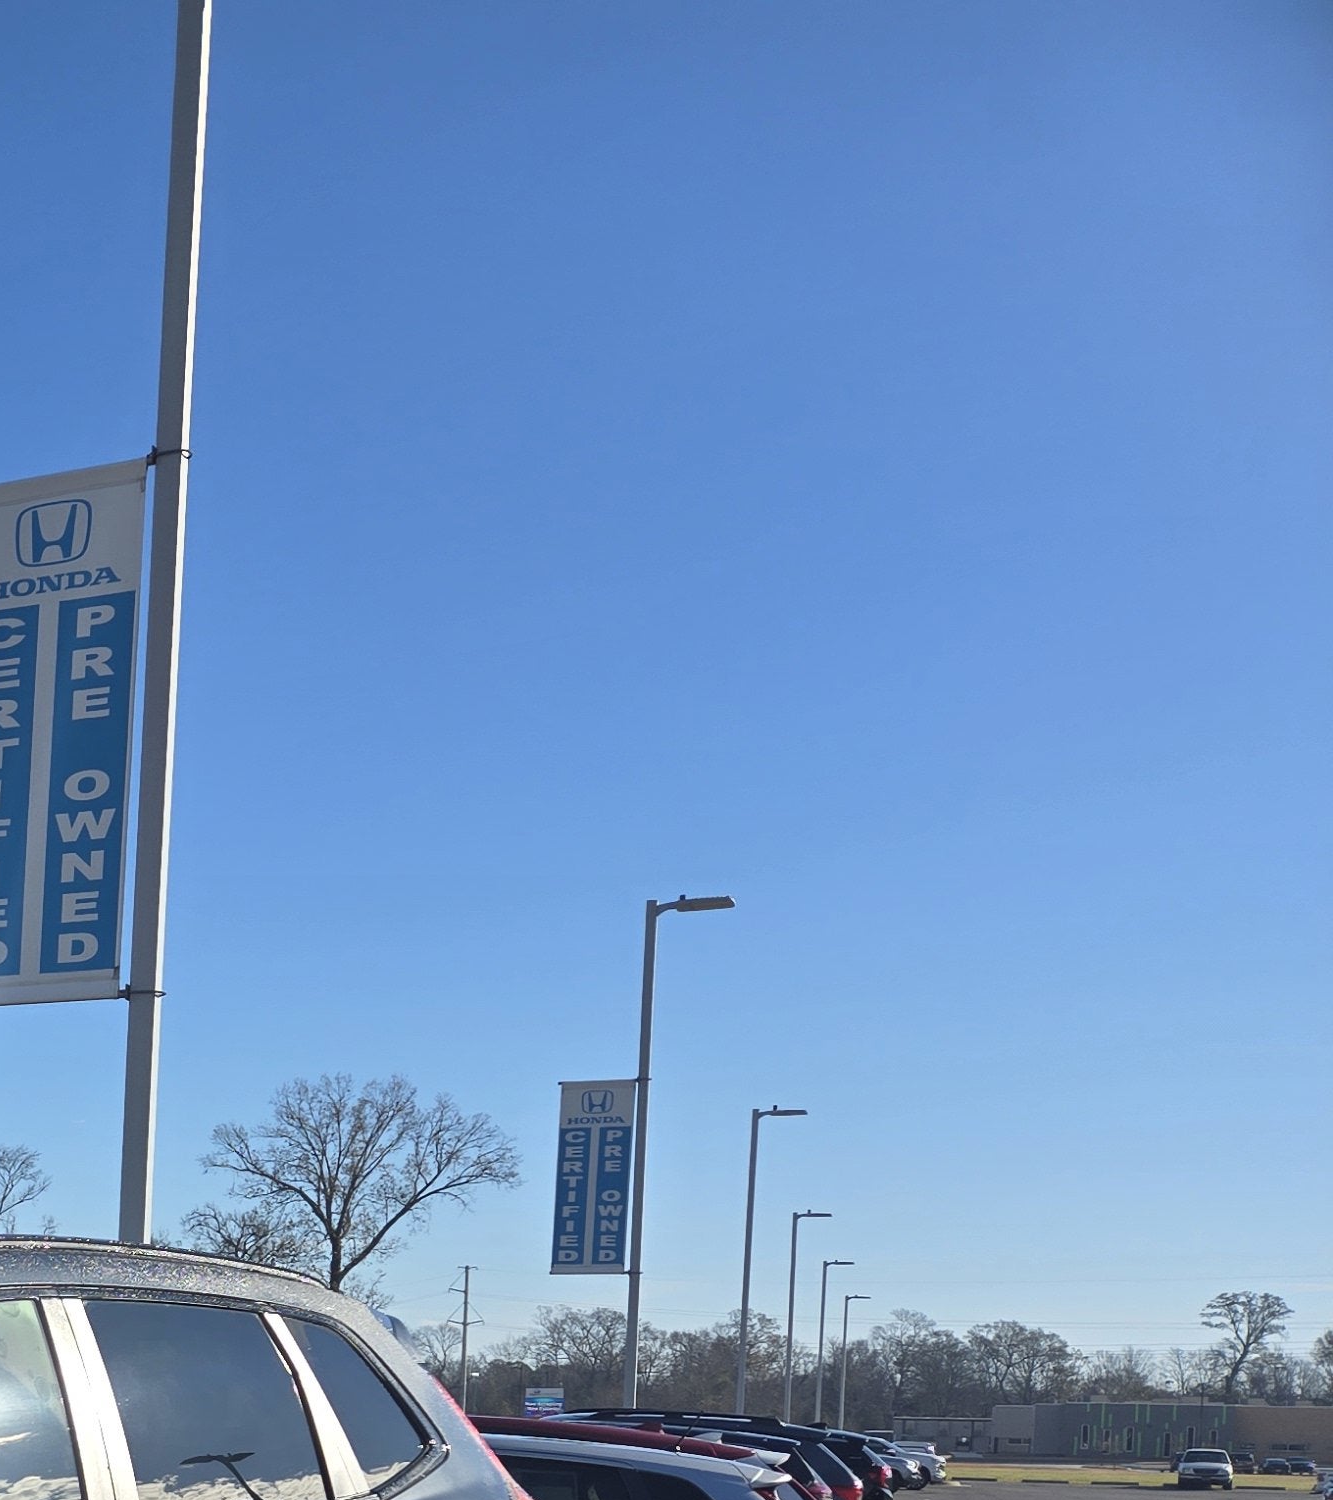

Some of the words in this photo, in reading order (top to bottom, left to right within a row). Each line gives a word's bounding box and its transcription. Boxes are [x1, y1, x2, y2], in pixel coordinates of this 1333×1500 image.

[70, 604, 115, 721] PRE
[55, 769, 116, 964] OWNED
[566, 1116, 626, 1125] HONDA
[603, 1130, 623, 1172] PRE
[557, 1131, 586, 1262] CERTIFIED
[598, 1189, 623, 1262] OWNED
